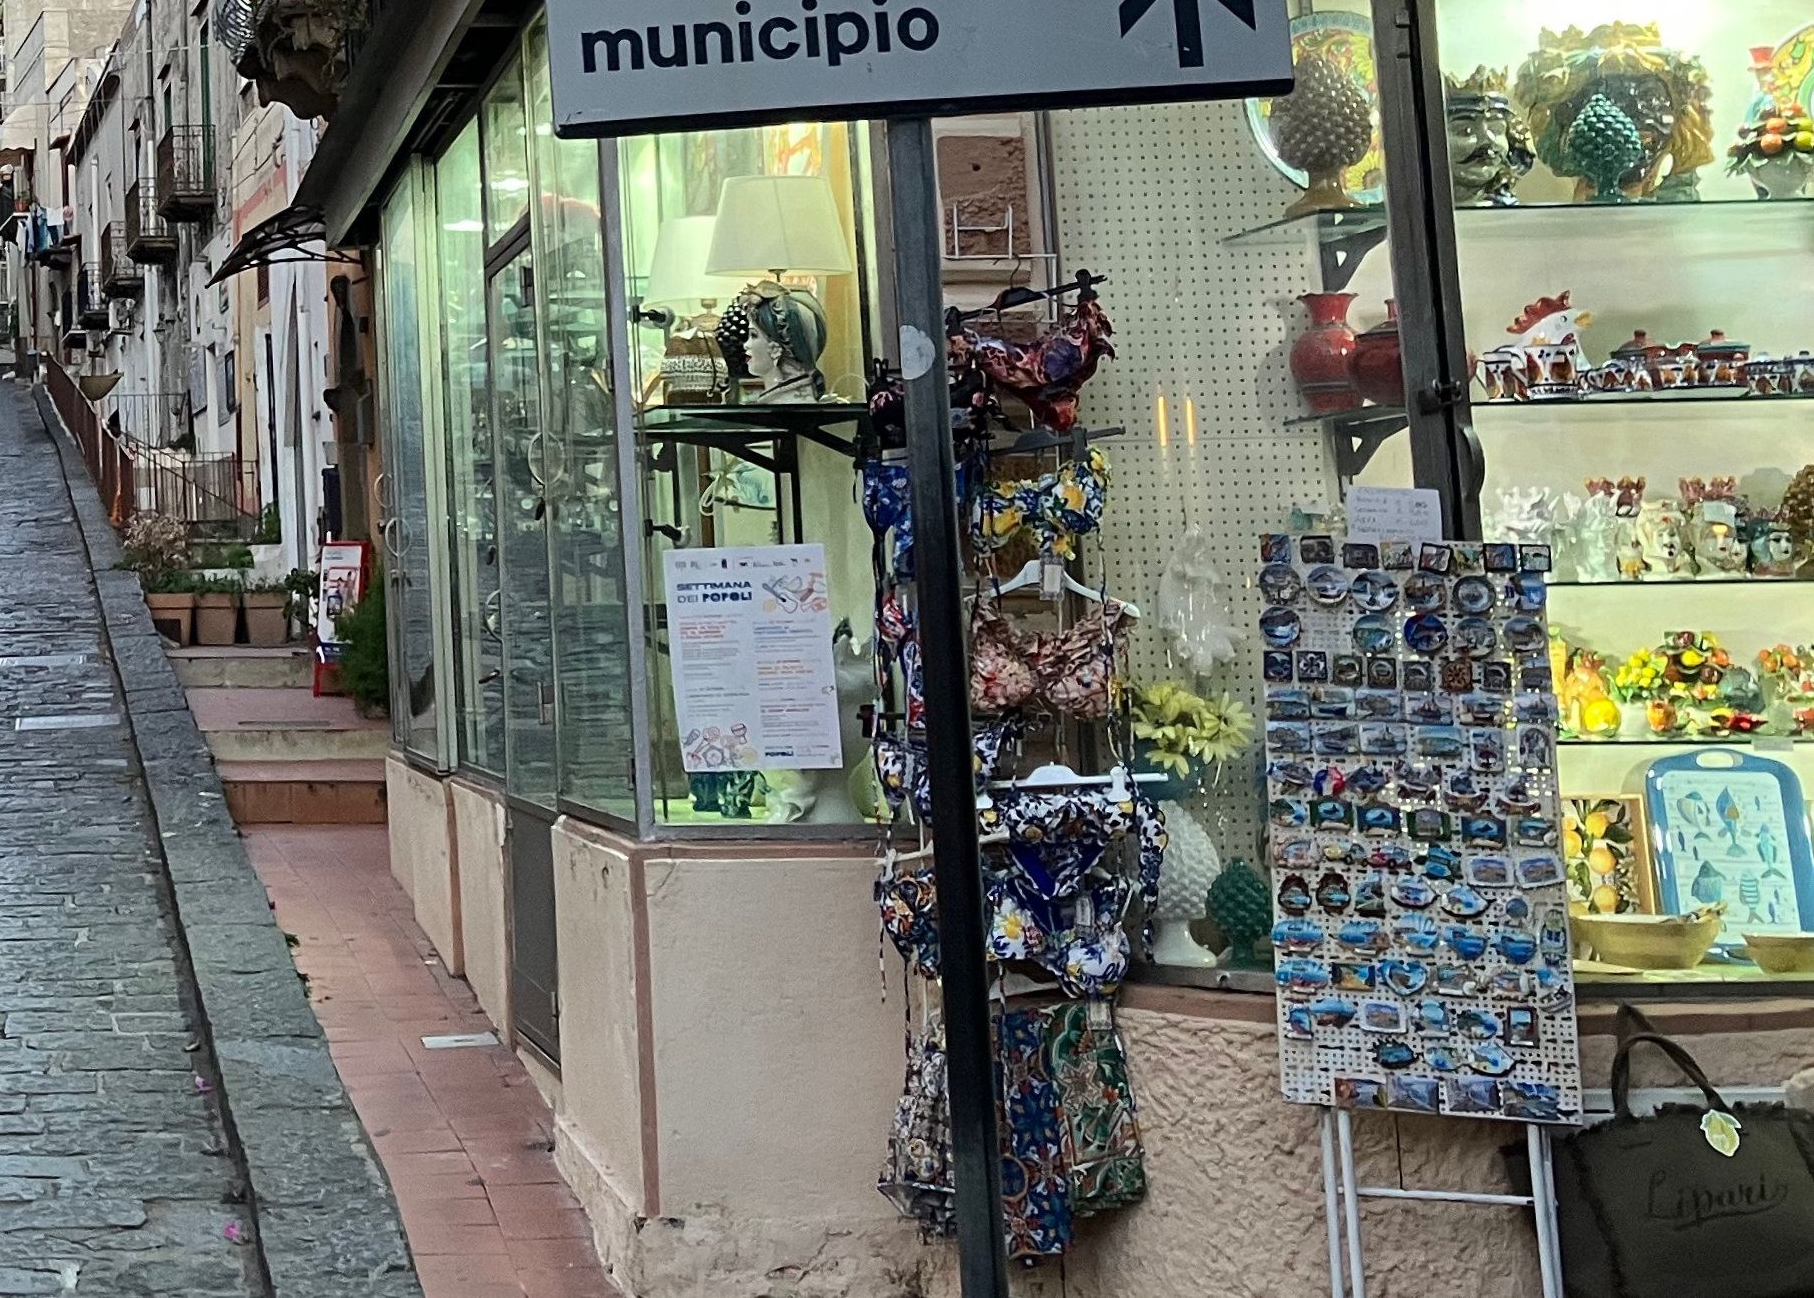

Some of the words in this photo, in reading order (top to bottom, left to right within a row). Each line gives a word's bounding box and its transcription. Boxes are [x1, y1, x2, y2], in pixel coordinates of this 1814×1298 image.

[676, 581, 752, 592] SETTIMANA
[677, 595, 698, 604] DEI
[702, 592, 752, 603] POPOLI
[1644, 1169, 1788, 1232] Lipari
